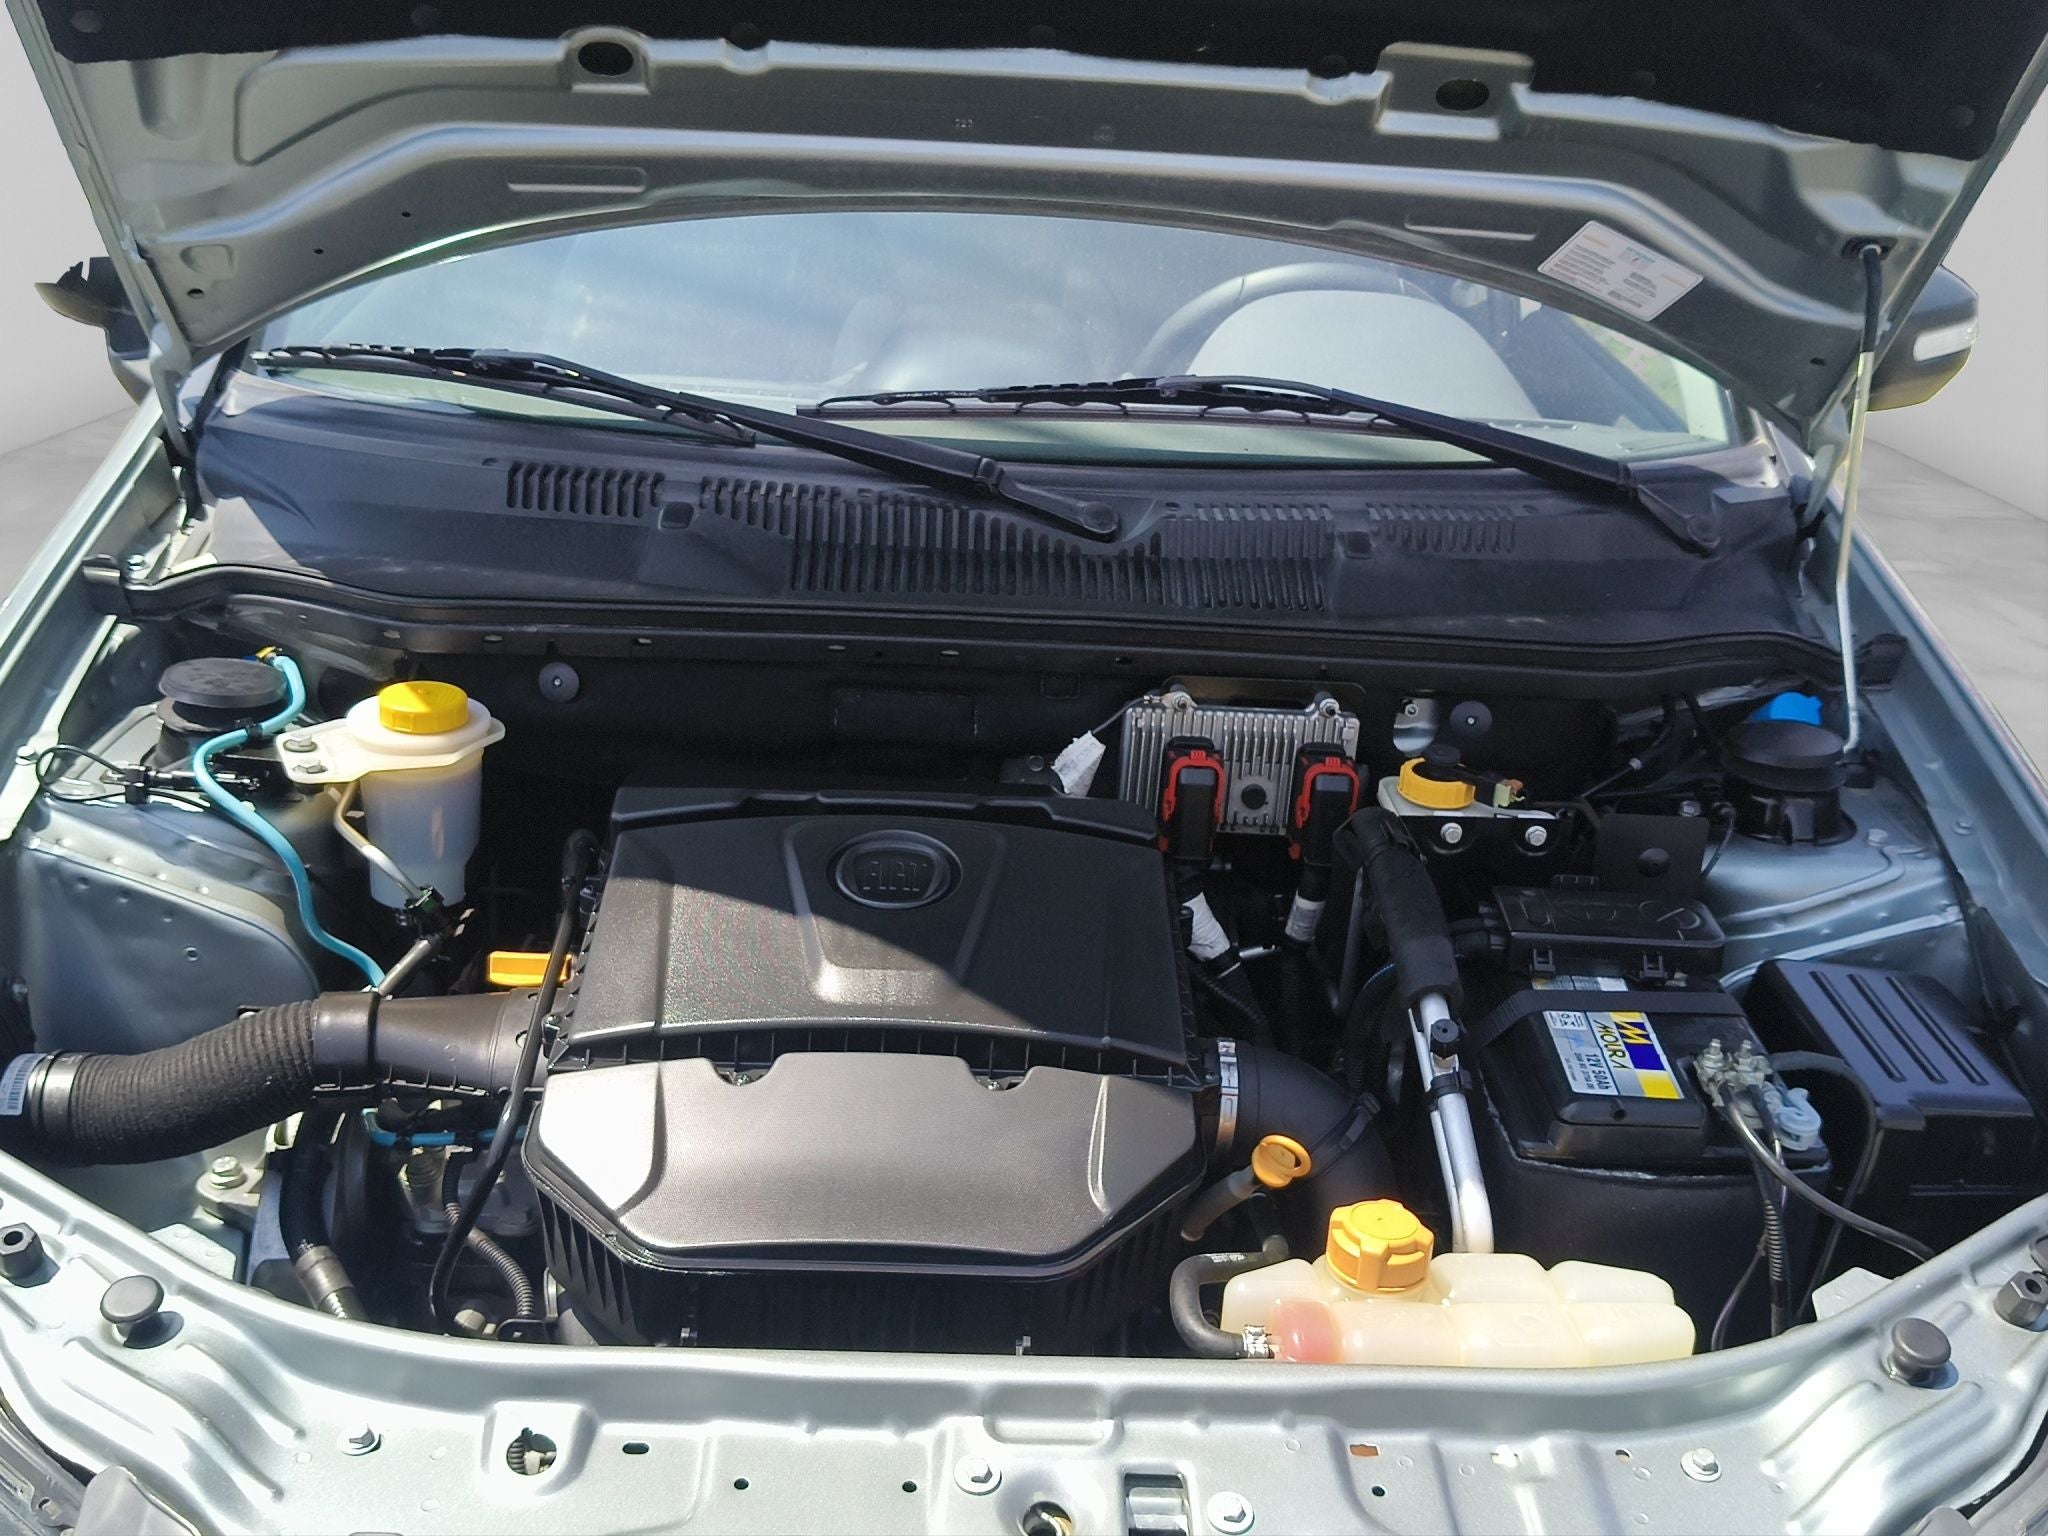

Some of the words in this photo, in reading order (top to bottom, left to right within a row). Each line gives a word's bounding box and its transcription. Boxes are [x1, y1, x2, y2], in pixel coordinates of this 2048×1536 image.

[1593, 1019, 1632, 1070] MOURA
[1585, 1053, 1604, 1069] 12V
[1591, 1069, 1613, 1090] 50Ah
